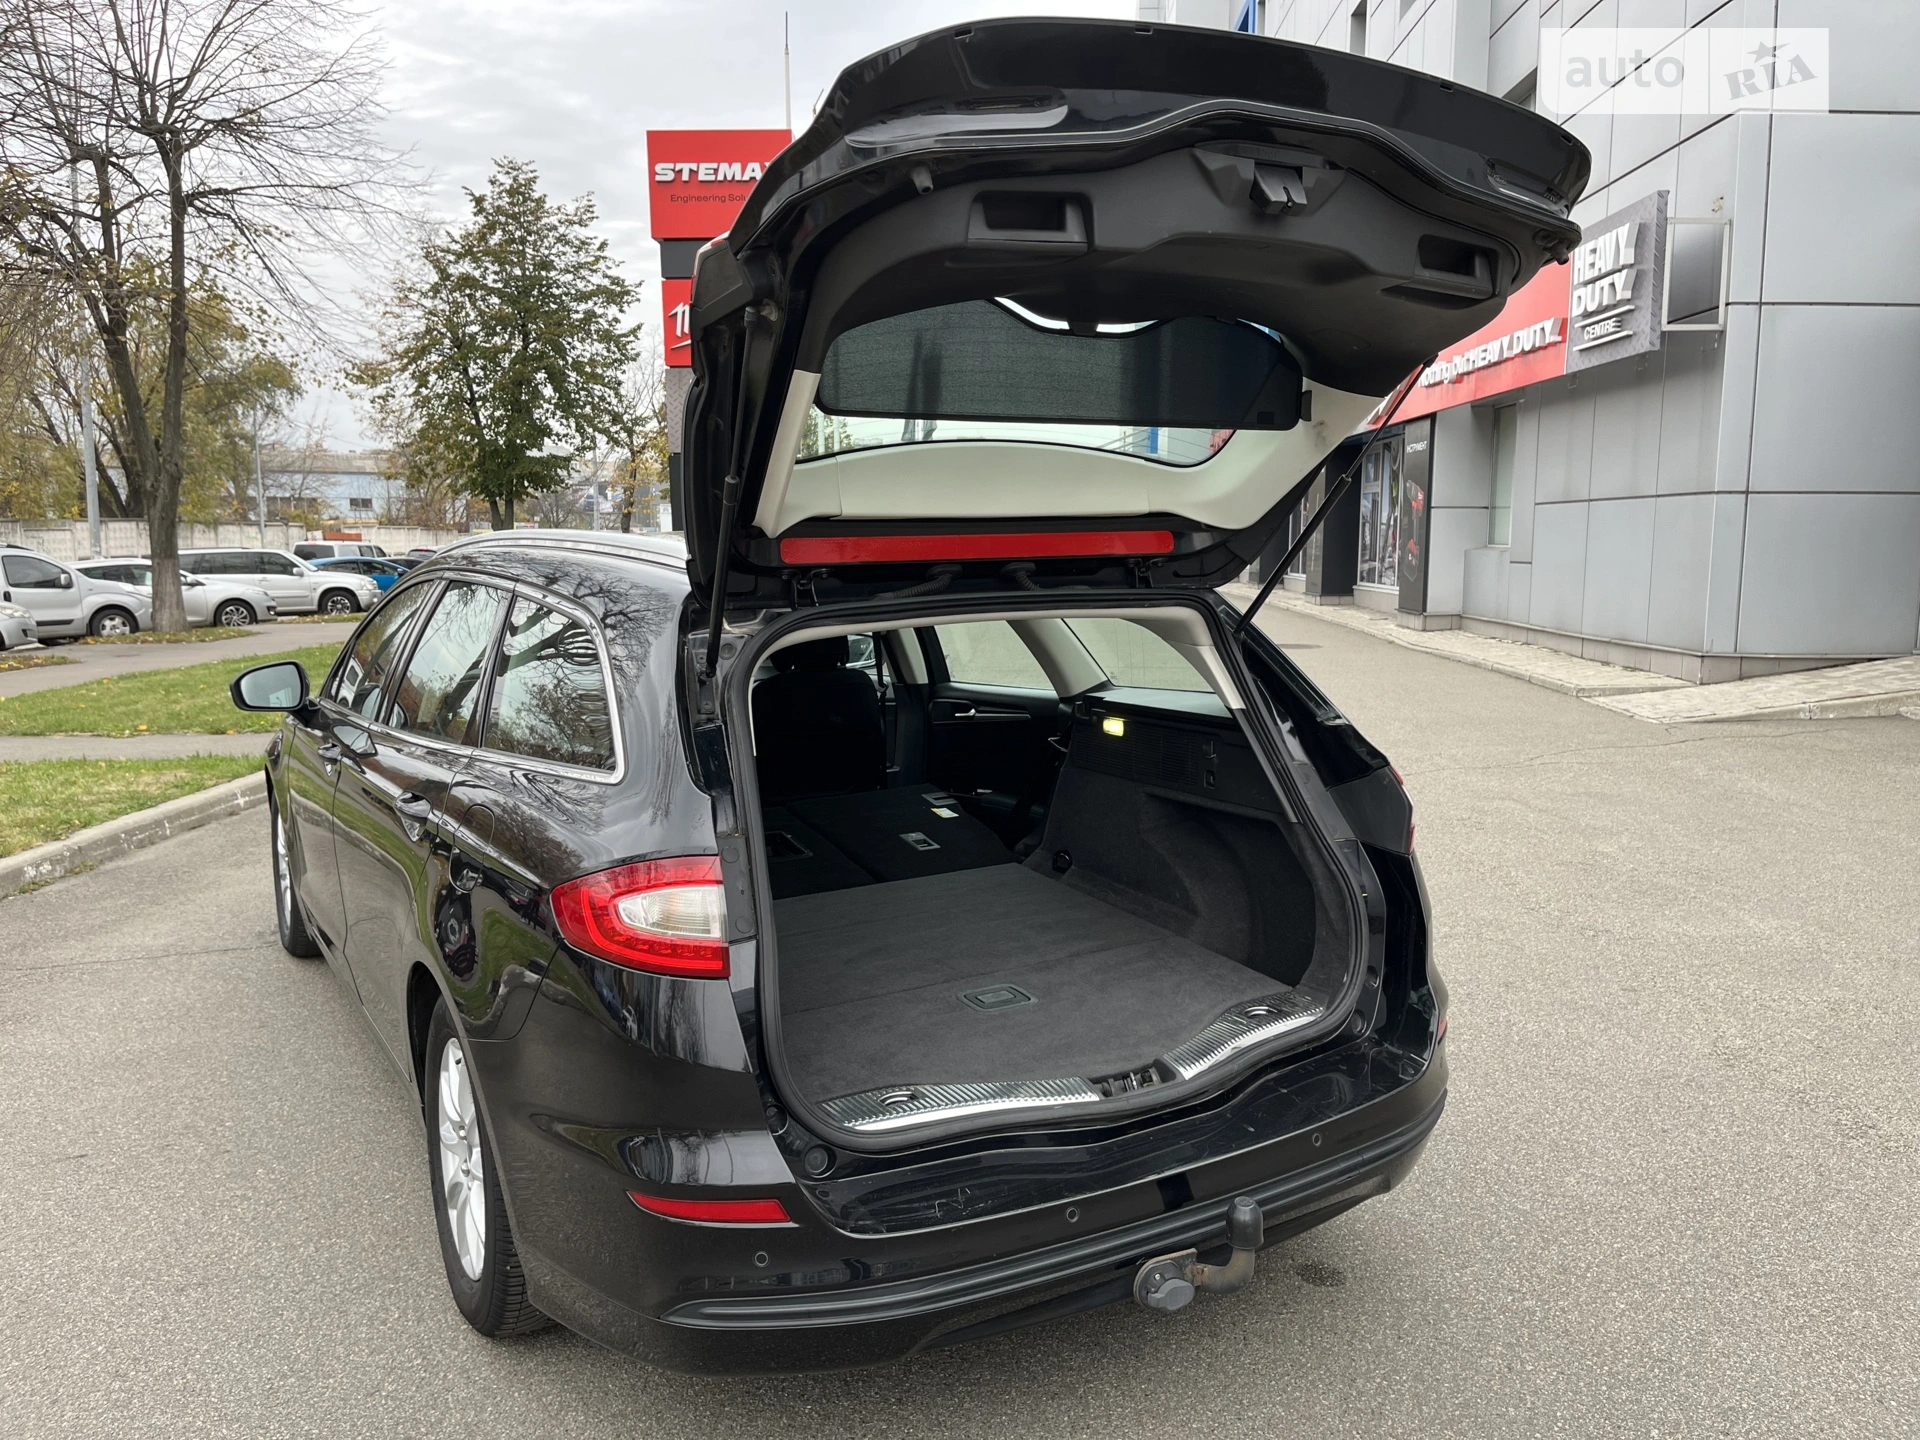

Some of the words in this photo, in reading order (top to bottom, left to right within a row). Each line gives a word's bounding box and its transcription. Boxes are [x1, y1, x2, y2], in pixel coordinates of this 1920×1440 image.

[670, 194, 726, 203] Engineering
[1573, 222, 1636, 285] HEAVY
[1571, 268, 1633, 318] DUTY
[1584, 317, 1621, 341] CENTRE
[1467, 334, 1514, 368] HEAVY
